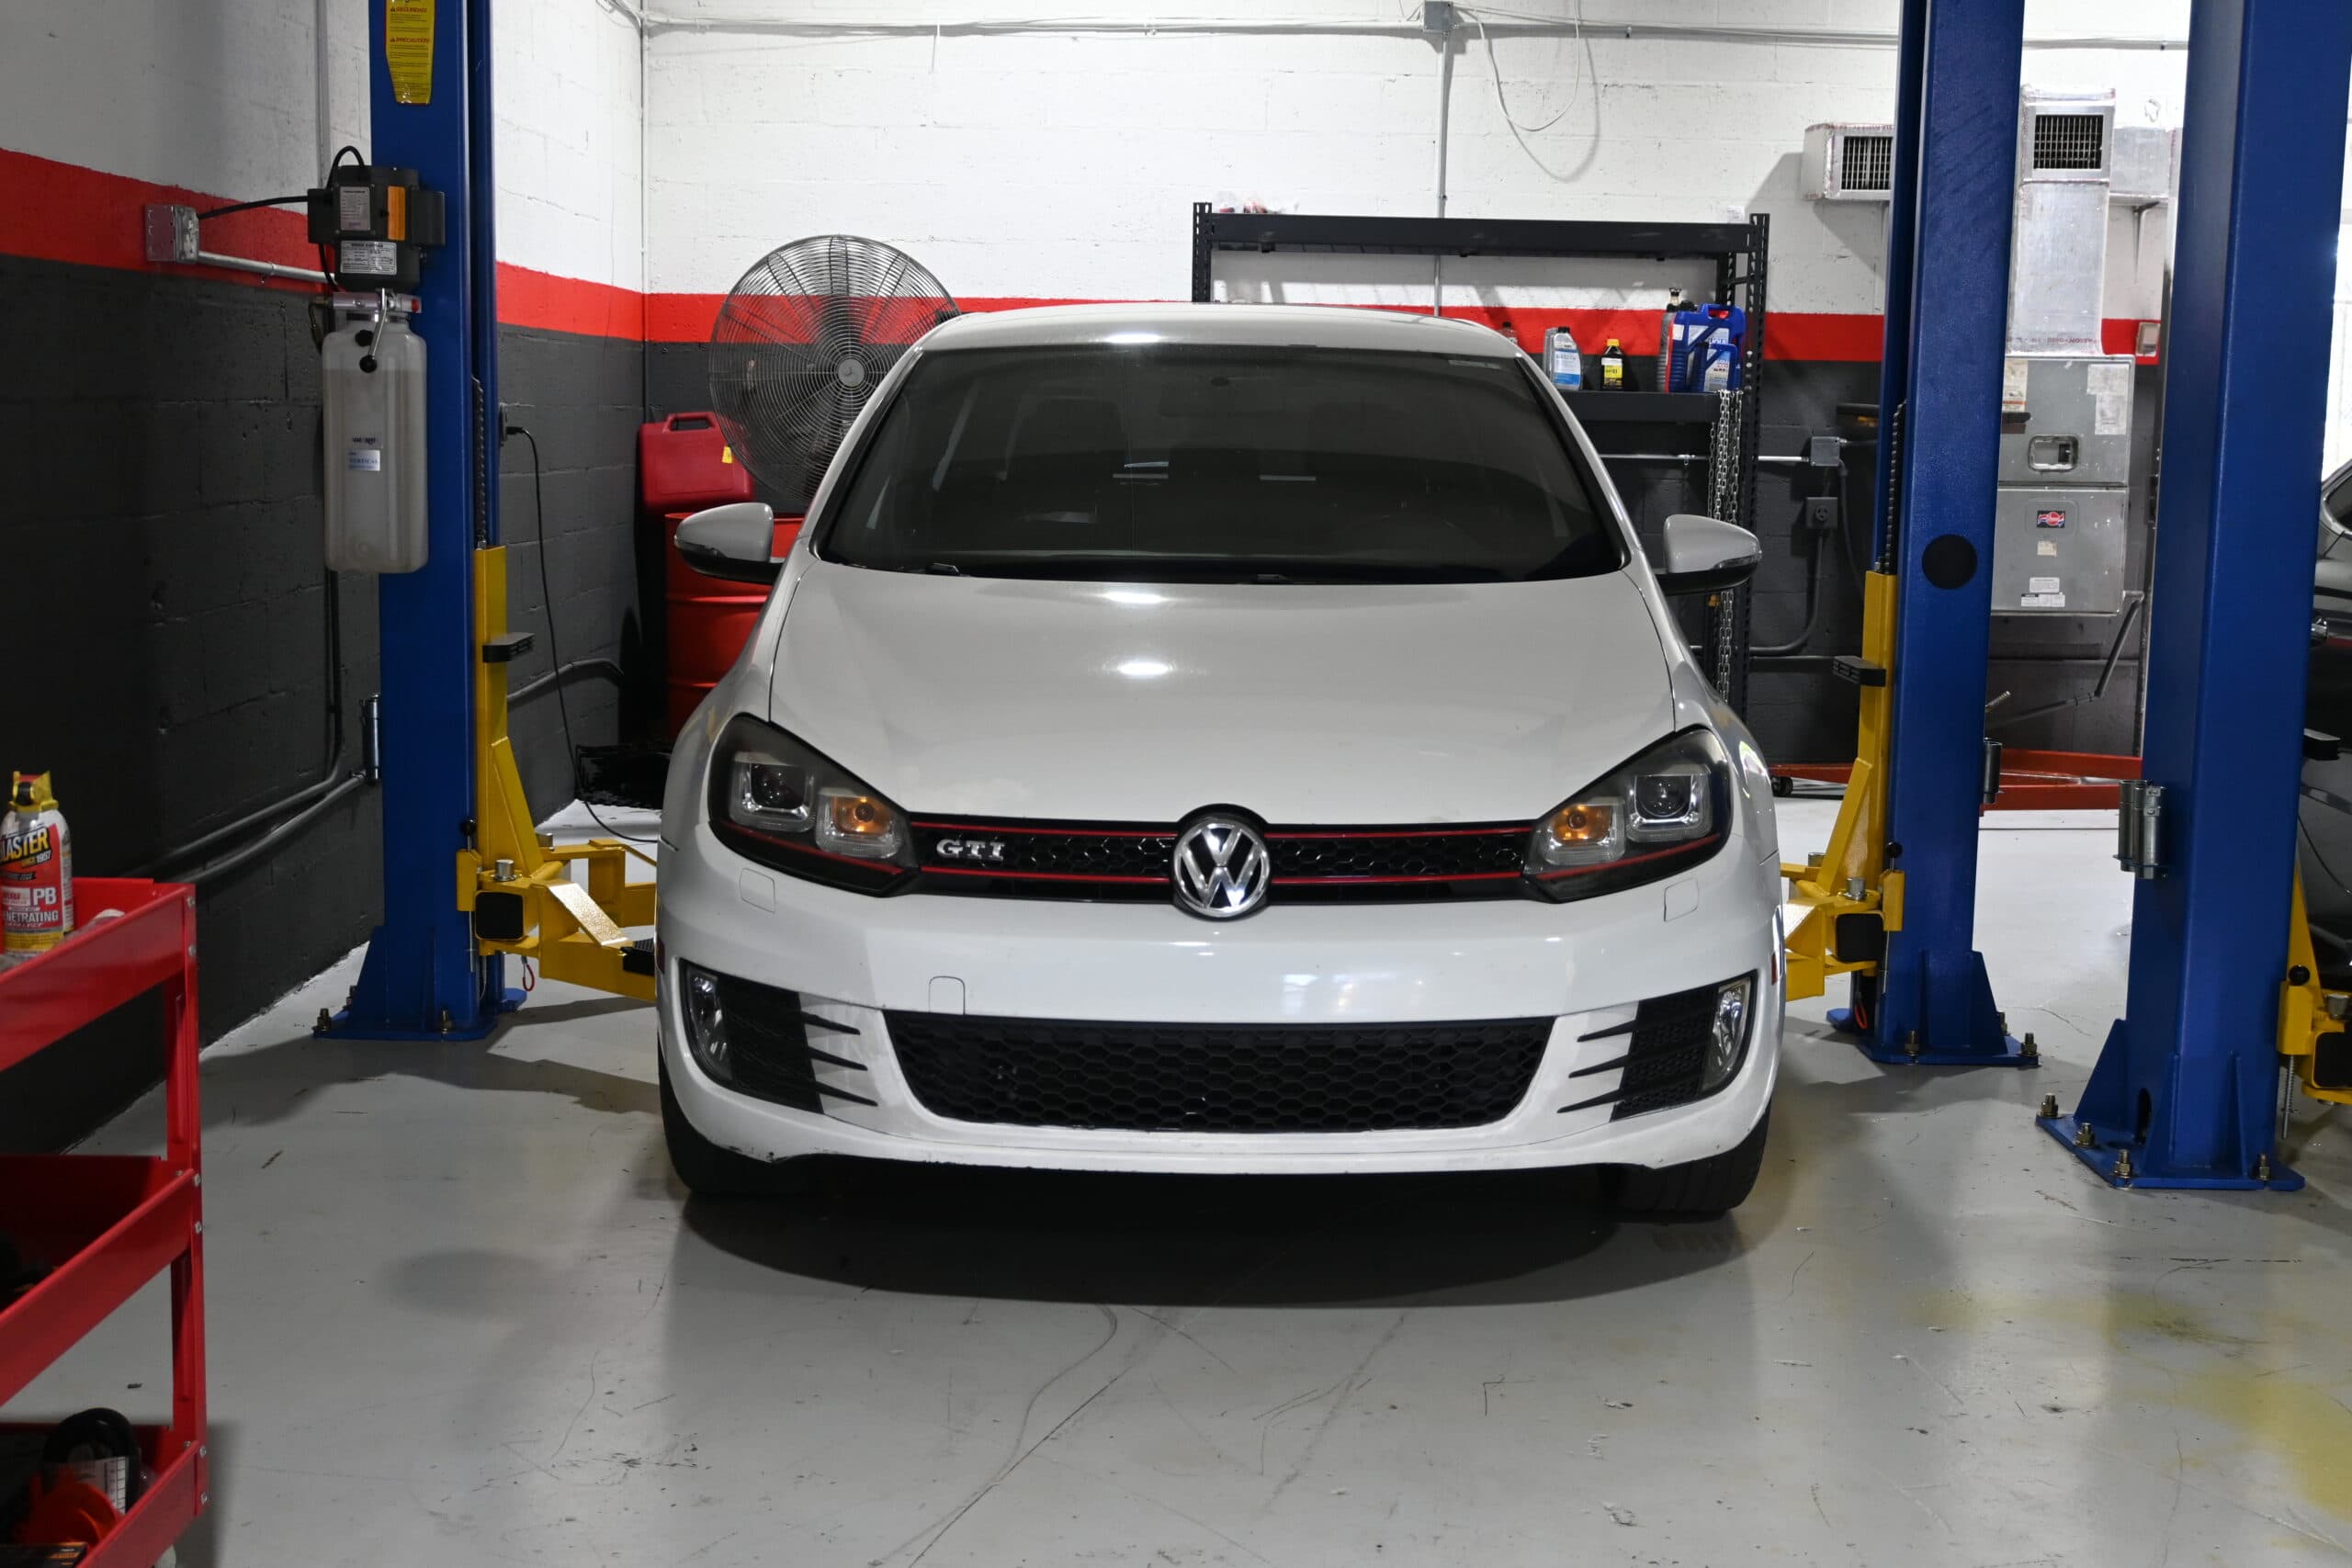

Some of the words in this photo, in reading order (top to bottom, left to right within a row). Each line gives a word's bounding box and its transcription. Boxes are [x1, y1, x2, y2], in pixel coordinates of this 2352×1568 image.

[0, 828, 50, 861] LASTER
[936, 839, 1006, 862] GTI
[33, 887, 57, 906] PB
